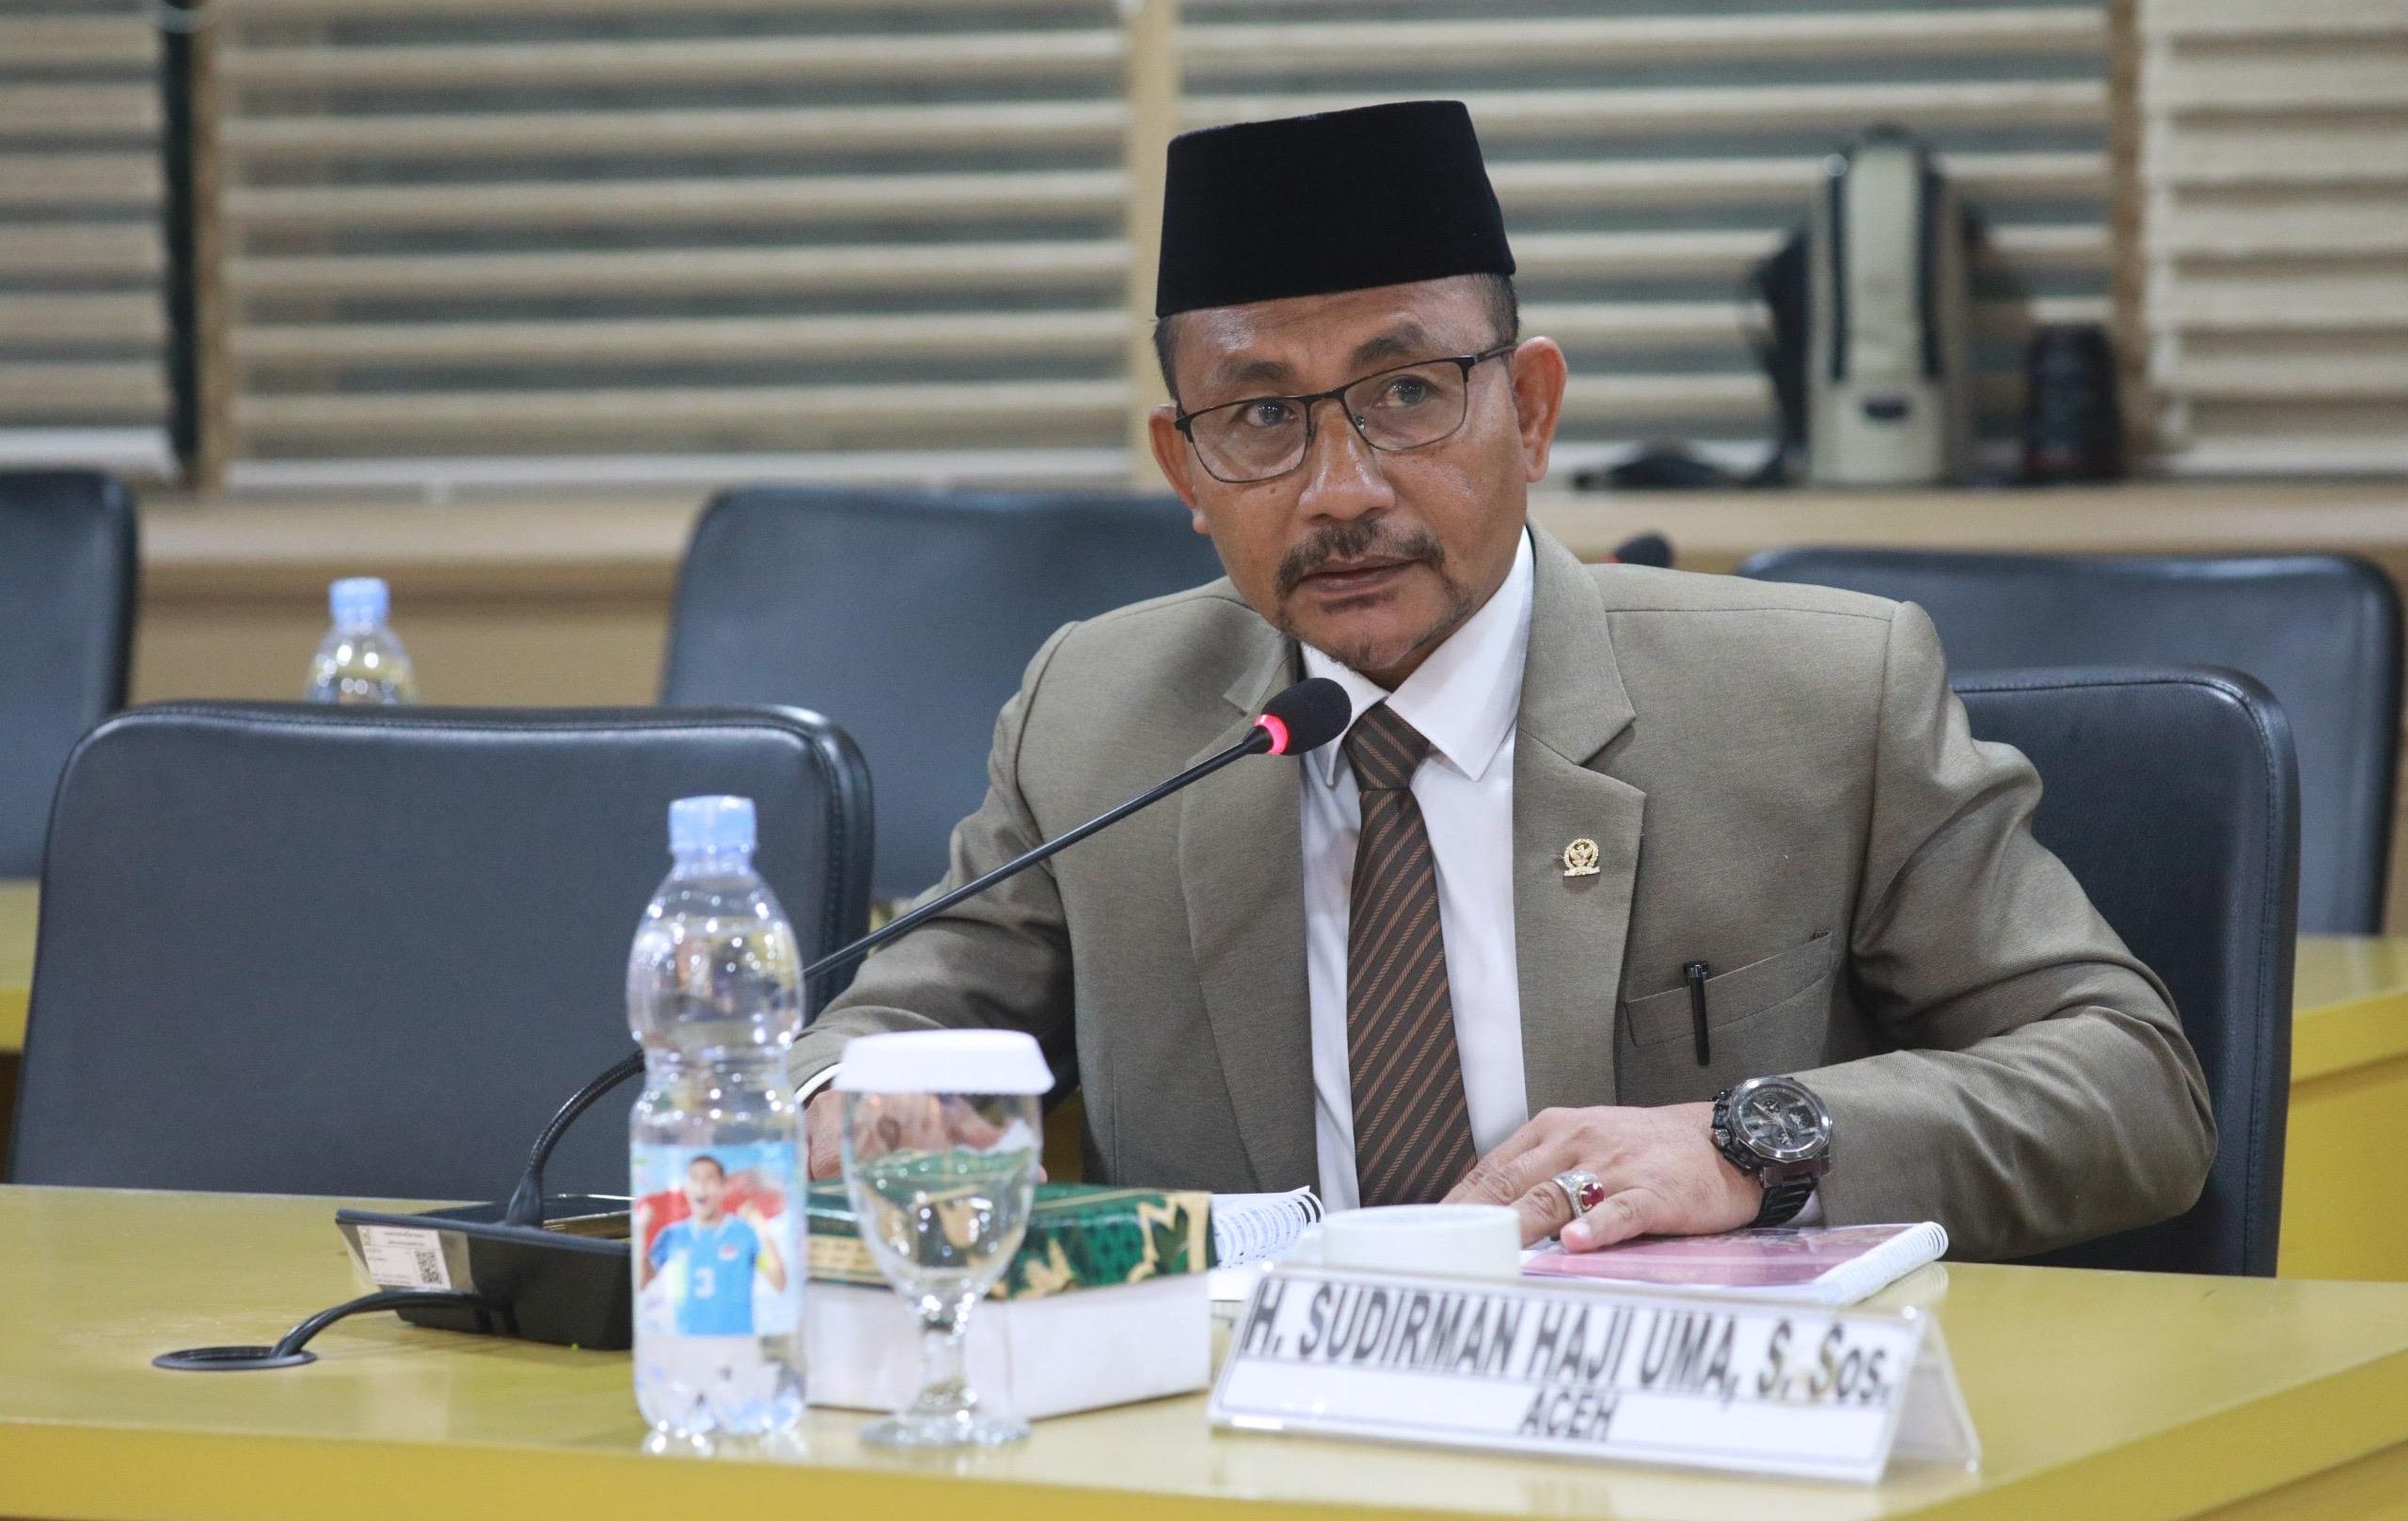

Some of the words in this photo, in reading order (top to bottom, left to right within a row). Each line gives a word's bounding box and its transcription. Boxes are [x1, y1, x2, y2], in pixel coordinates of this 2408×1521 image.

[693, 1266, 715, 1299] 3
[1244, 1277, 1286, 1355] H.
[1298, 1280, 1524, 1372] SUDIRMAN
[1526, 1302, 1635, 1384] HAJI
[1640, 1307, 1738, 1409] UMA,
[1757, 1319, 1792, 1399] S.
[1517, 1389, 1619, 1442] ACEH
